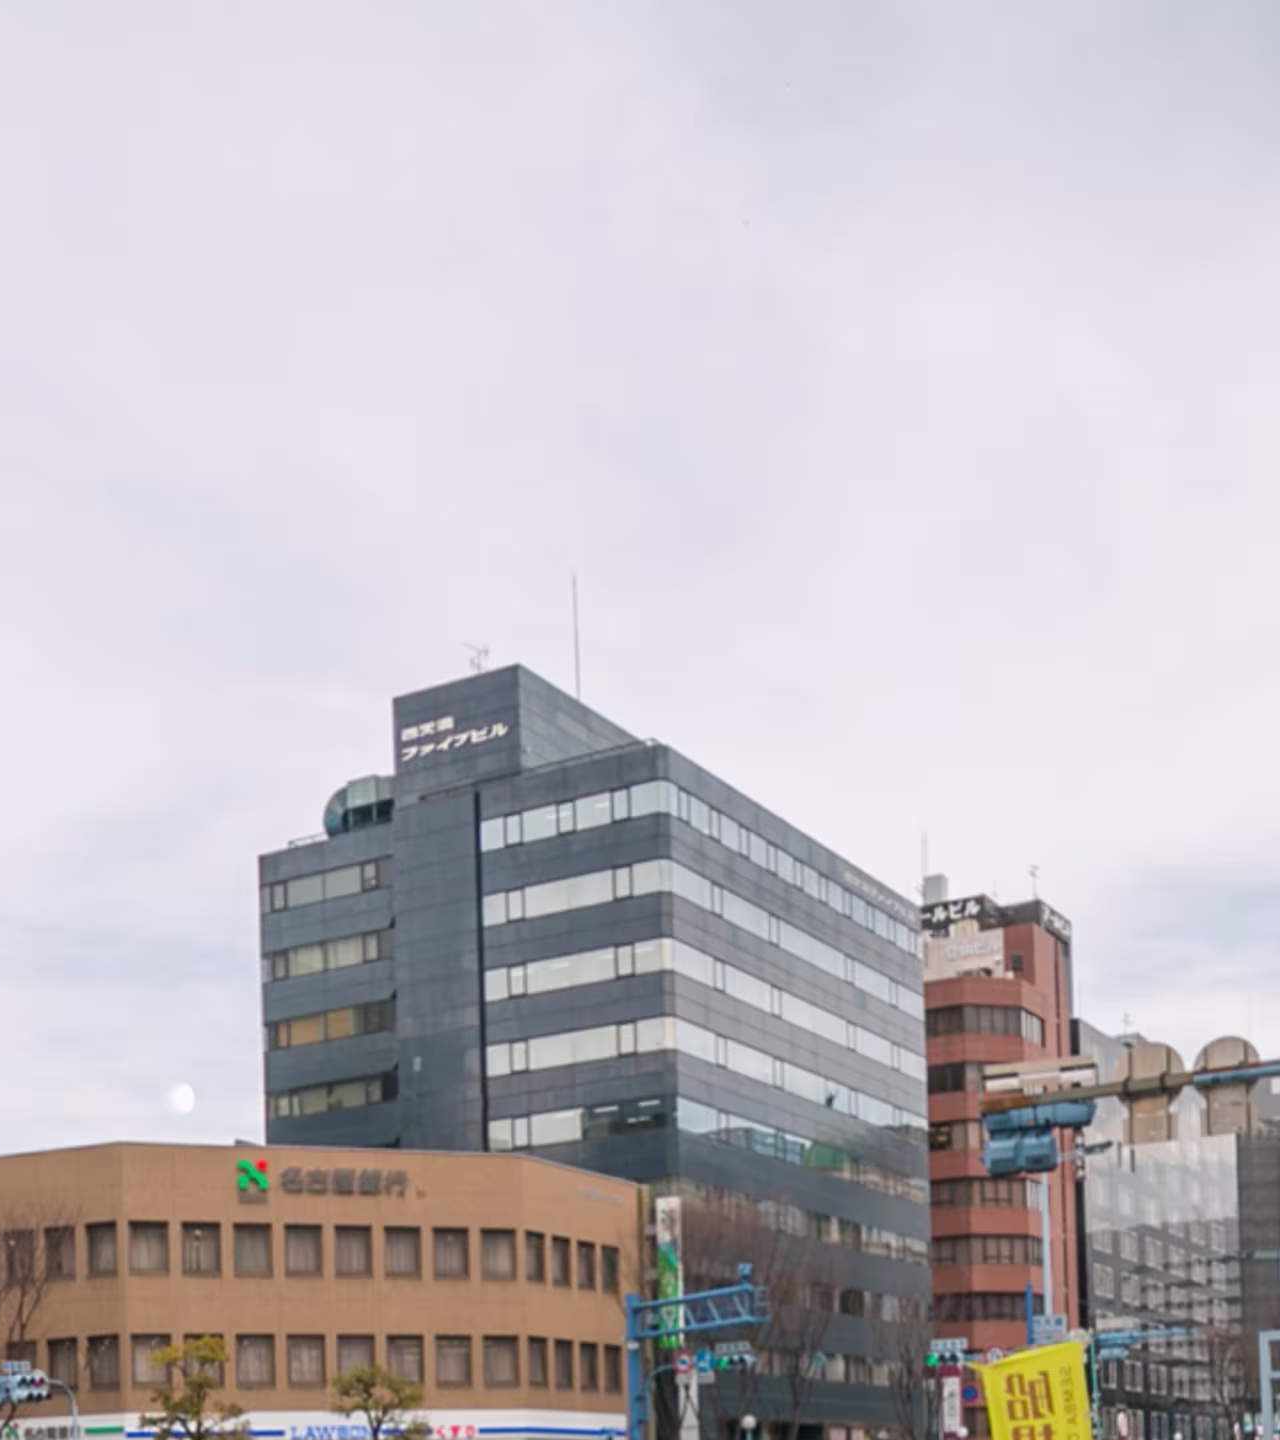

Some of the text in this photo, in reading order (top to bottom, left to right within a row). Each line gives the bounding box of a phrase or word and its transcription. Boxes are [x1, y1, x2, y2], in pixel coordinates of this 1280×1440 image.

[280, 1166, 408, 1198] 名古屋銀行
